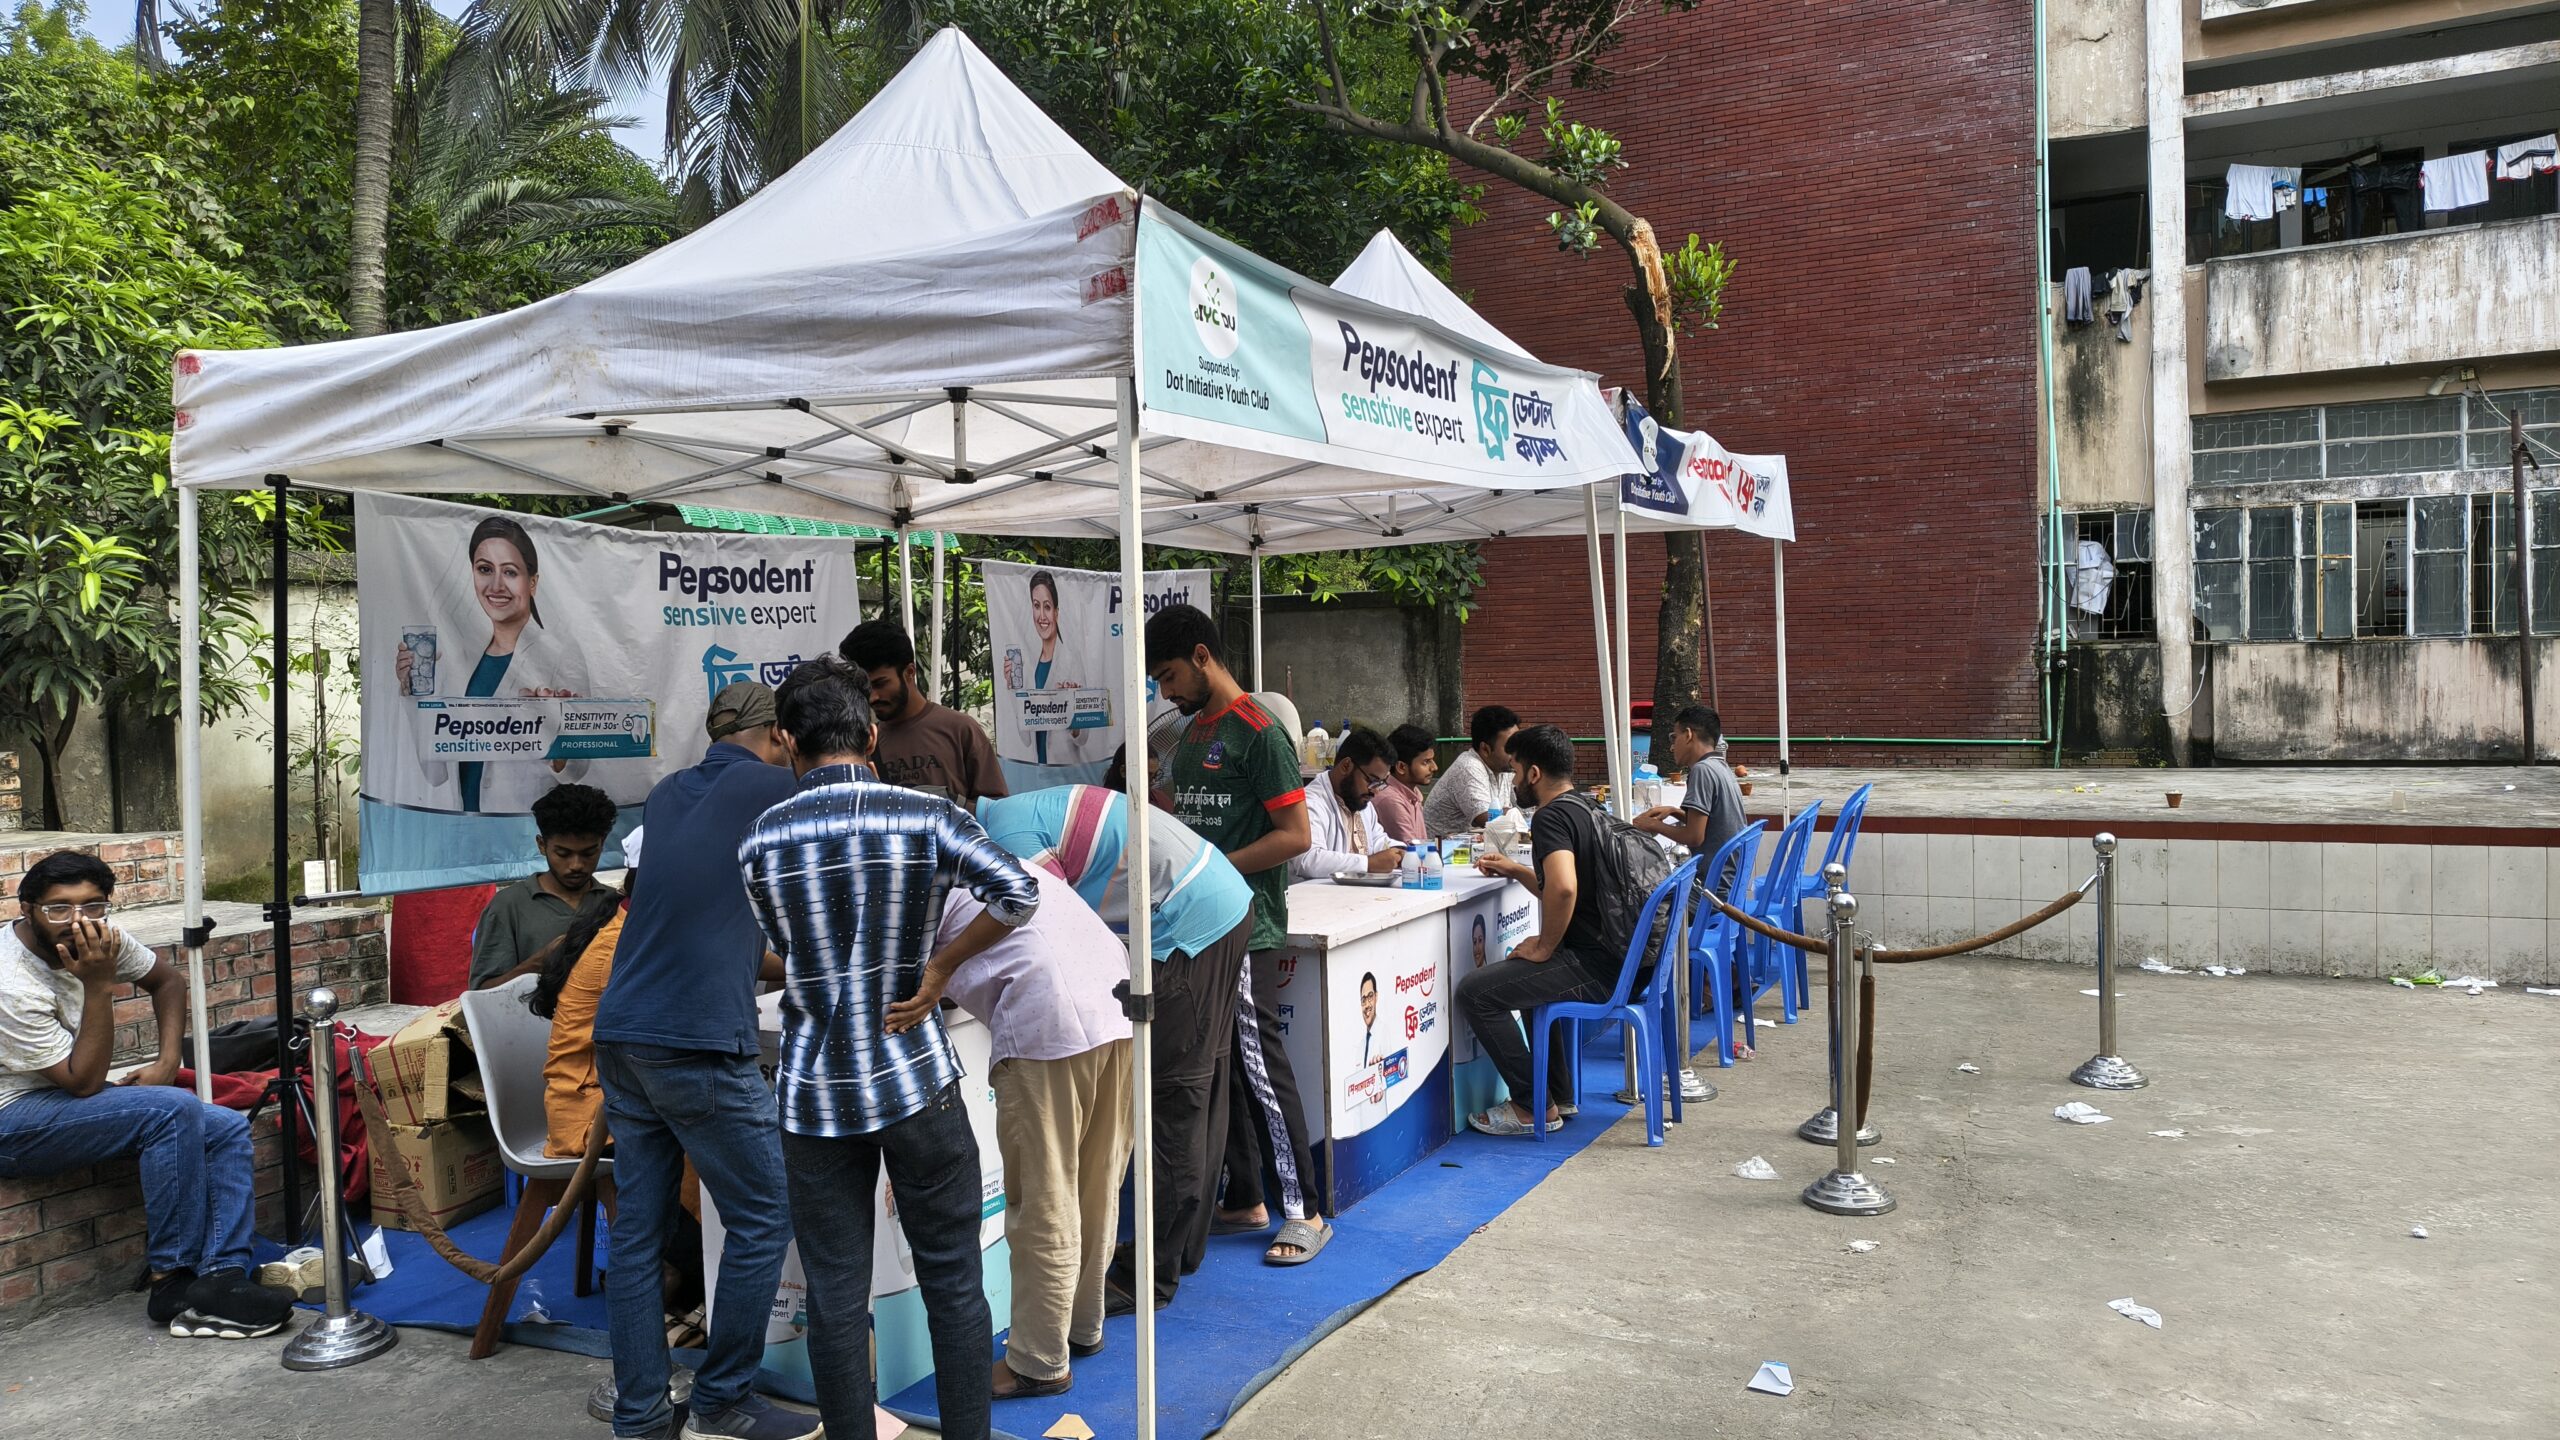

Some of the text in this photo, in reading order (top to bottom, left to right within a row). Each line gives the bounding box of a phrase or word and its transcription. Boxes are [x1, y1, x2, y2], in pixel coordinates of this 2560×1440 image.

[1199, 356, 1230, 376] Supported
[1337, 319, 1458, 403] Pepsodent
[1166, 369, 1270, 411] Dot Initiative Youth Club
[1341, 391, 1465, 446] sensitive expert
[1471, 358, 1510, 462] ফ্রি
[1512, 390, 1556, 430] ডেন্টাল
[659, 551, 815, 602] Pepsodent
[751, 603, 817, 630] expert
[434, 713, 543, 740] Pepsodent
[564, 712, 618, 722] SENSITIVITY
[564, 722, 592, 731] RELIEF
[592, 722, 602, 731] IN
[434, 739, 543, 754] sensitive expert
[561, 741, 619, 749] PROFESSIONAL
[1216, 793, 1231, 808] হল
[1497, 901, 1531, 931] Pepsodent
[1497, 919, 1531, 945] sensitive expert
[1395, 962, 1437, 994] Pepsodent
[1405, 1005, 1418, 1040] ফ্রি
[770, 1310, 790, 1319] xpert
